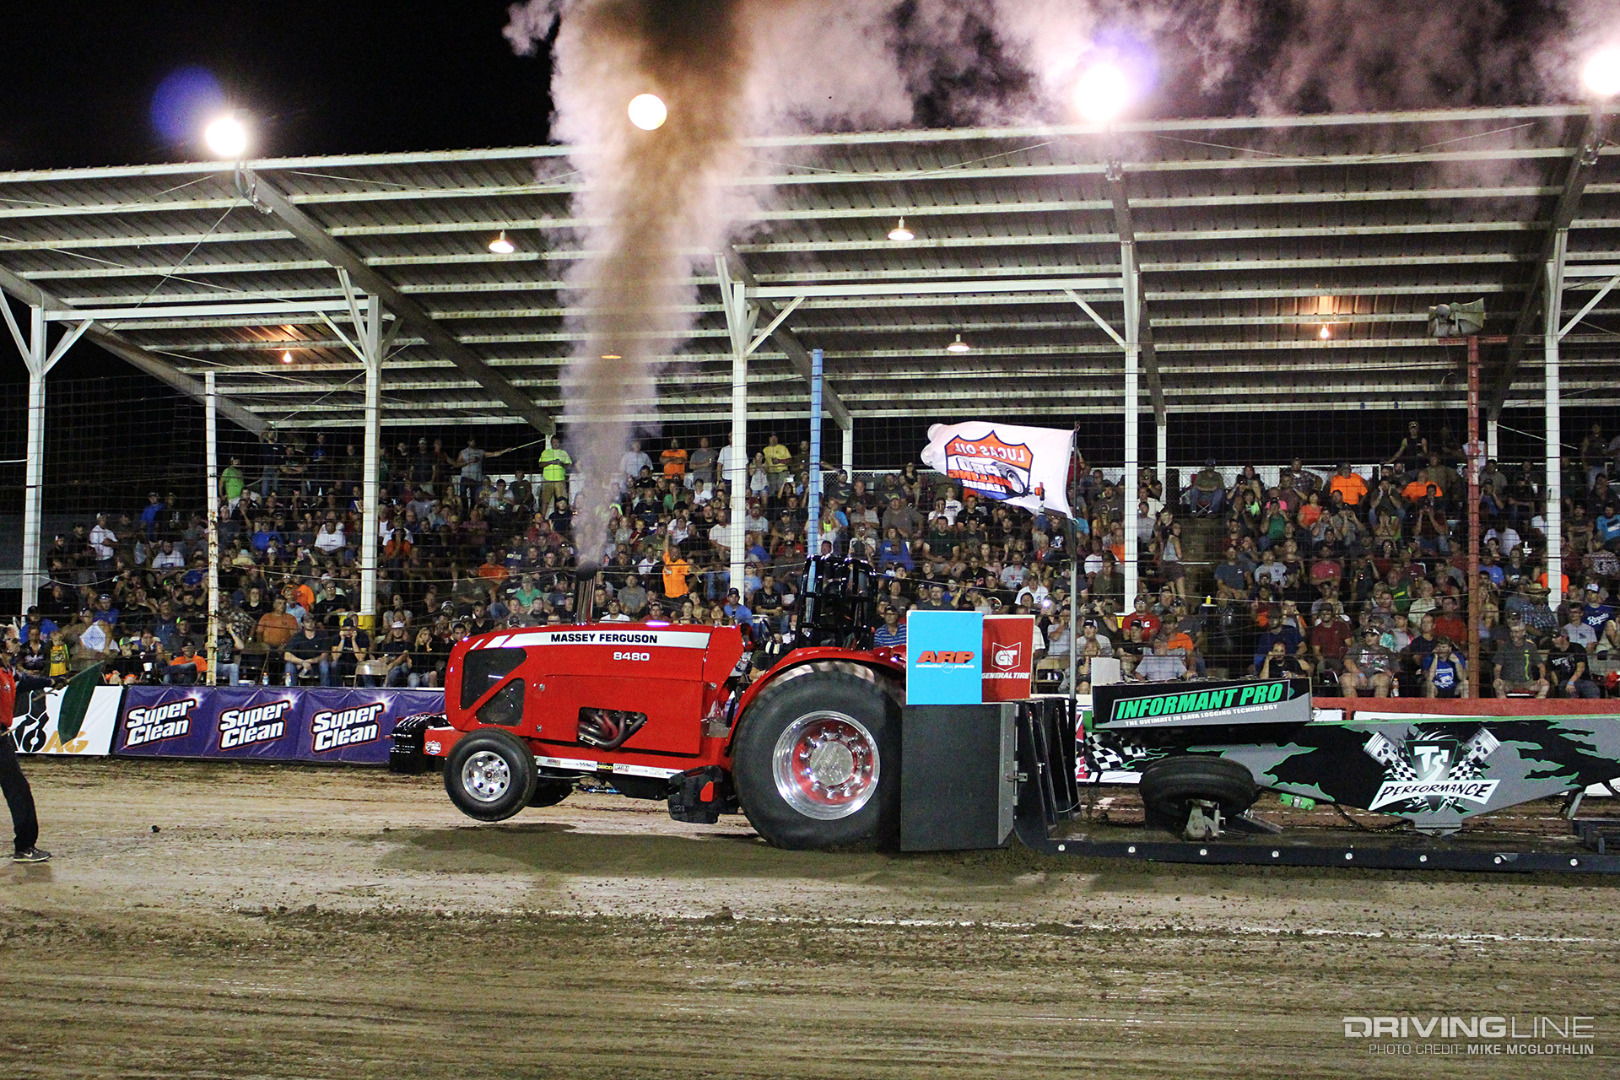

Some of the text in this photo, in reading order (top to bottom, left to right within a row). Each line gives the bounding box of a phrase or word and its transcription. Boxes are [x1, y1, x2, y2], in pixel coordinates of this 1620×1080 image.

[550, 633, 658, 644] MASSEY FERGUSON
[613, 651, 651, 661] 8480
[916, 651, 975, 664] ARP
[995, 650, 1018, 665] GT
[982, 672, 1031, 680] GENERAL TIRE
[126, 700, 195, 728] Super
[1116, 683, 1283, 720] INFORMANT PRO
[1140, 717, 1173, 725] ULTIMATE
[1201, 709, 1232, 718] LOGGING
[1233, 704, 1278, 714] TECHNOLOGY
[220, 702, 290, 731] Super
[312, 704, 383, 733] Super
[127, 719, 190, 746] Clean
[221, 721, 284, 749] Clean
[314, 724, 379, 751] Clean
[1414, 745, 1450, 781] TS
[1376, 783, 1492, 803] PERFORMANCE
